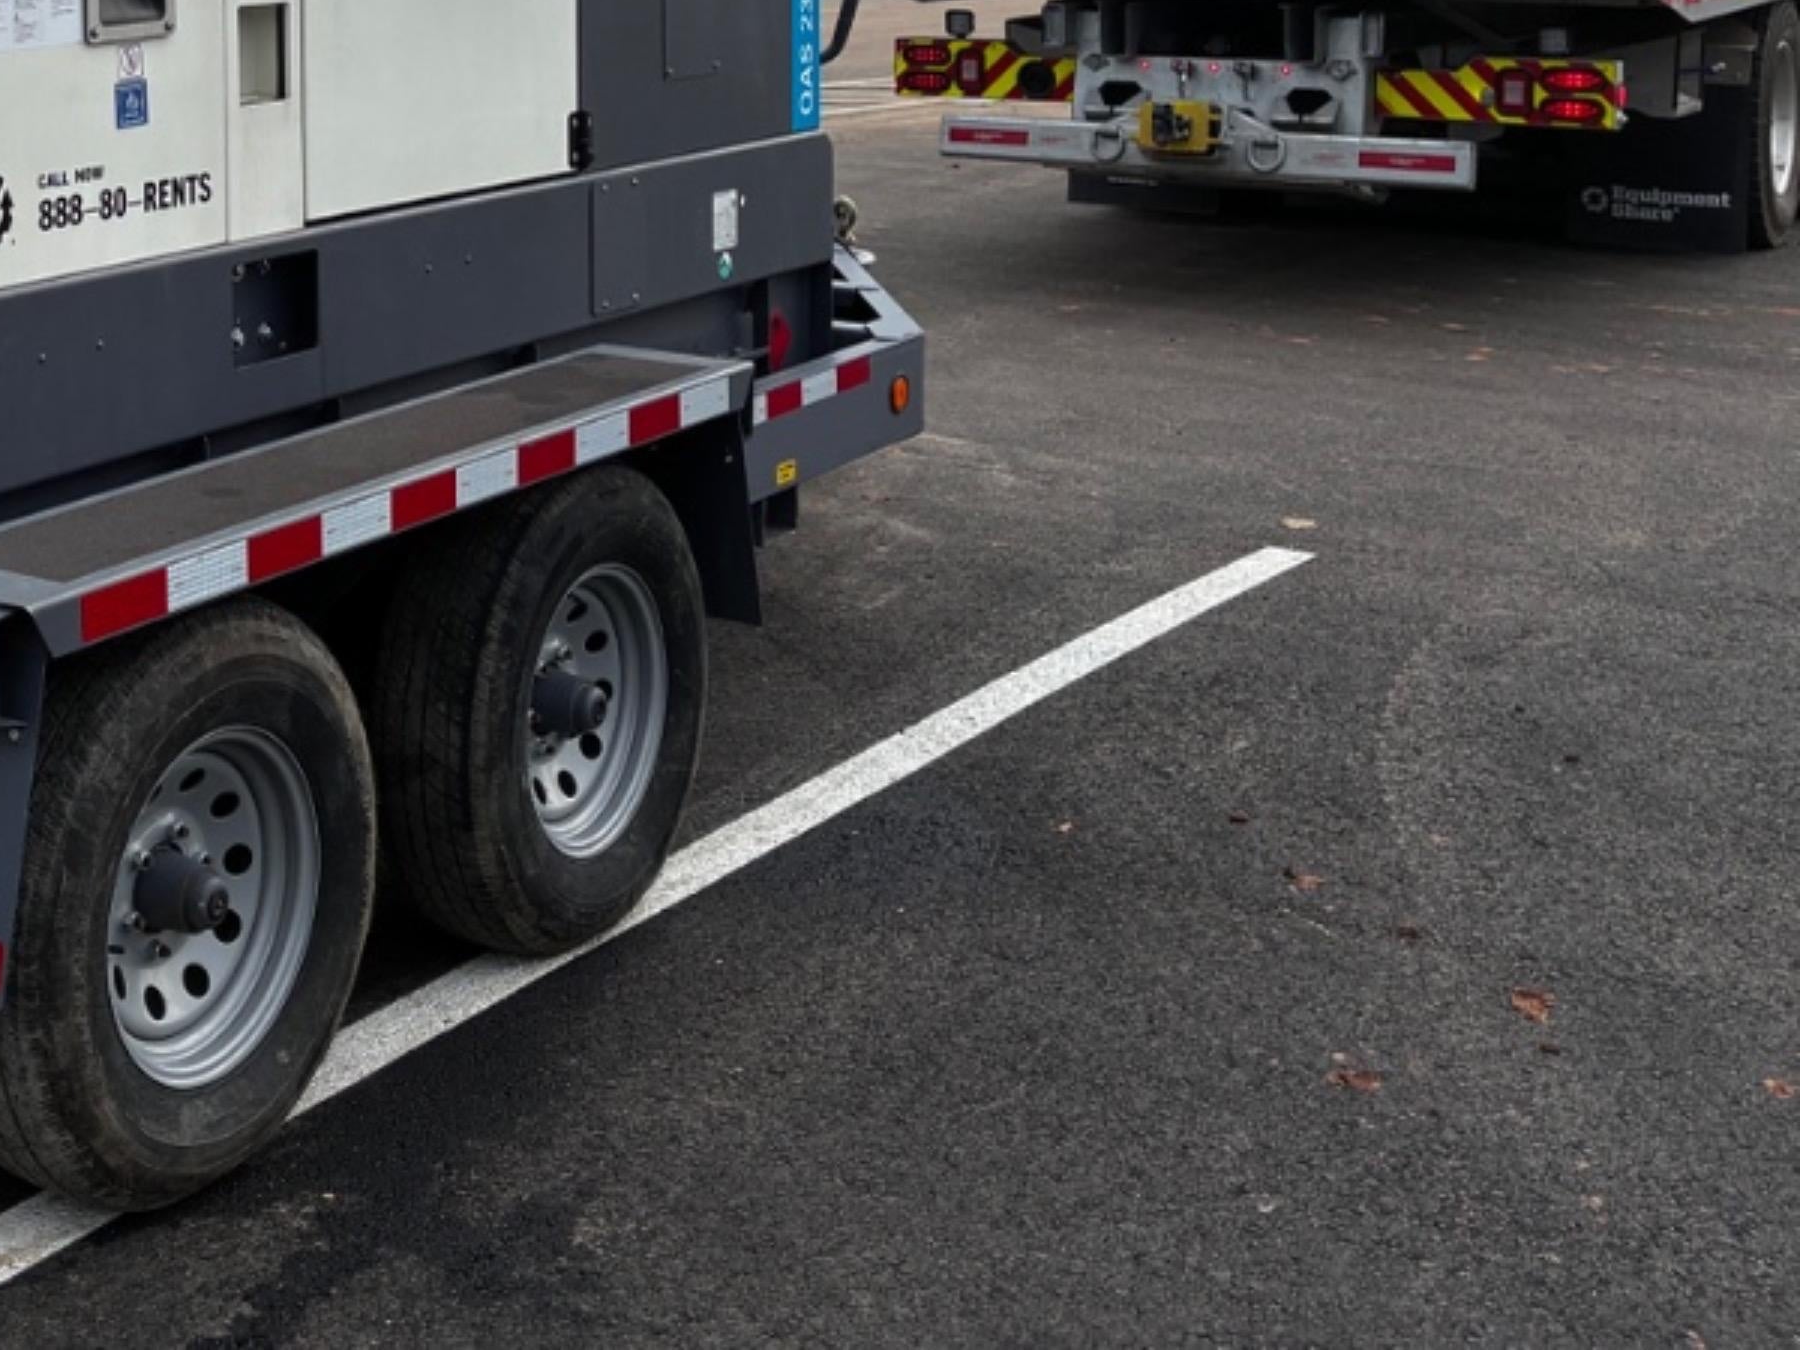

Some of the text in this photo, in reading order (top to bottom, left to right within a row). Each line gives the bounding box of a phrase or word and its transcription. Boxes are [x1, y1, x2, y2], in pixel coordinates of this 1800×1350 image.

[37, 165, 105, 190] CALL NOW
[38, 171, 212, 231] 888-80-RENTS
